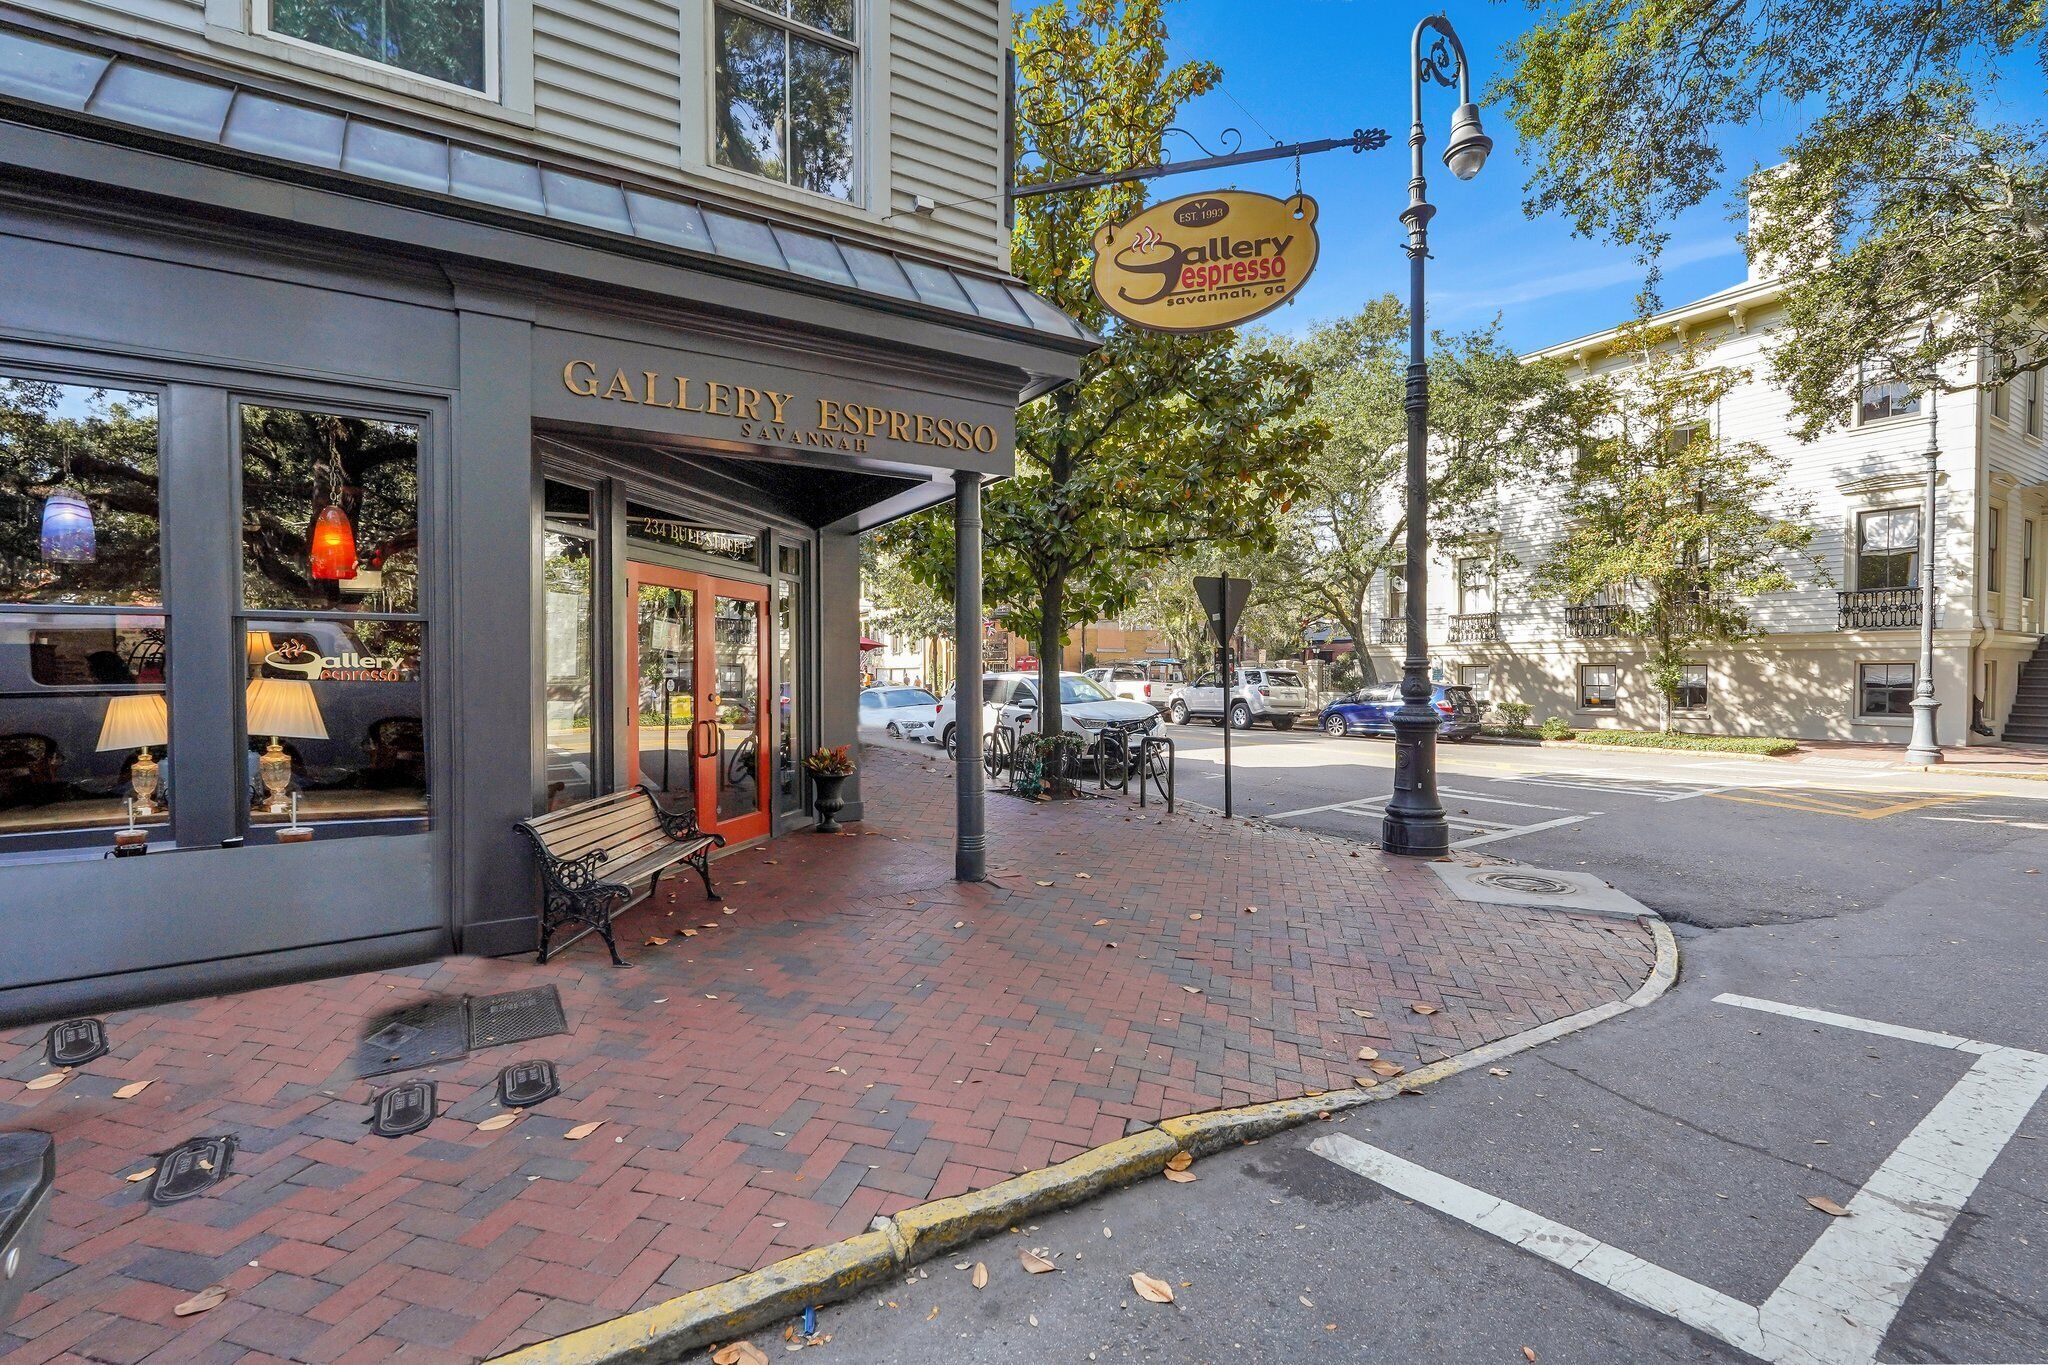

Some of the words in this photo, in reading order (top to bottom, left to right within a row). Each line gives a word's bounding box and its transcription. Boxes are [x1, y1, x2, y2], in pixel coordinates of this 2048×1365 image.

[1179, 211, 1198, 223] EST.
[1201, 208, 1224, 219] 1993
[1114, 235, 1294, 305] Gallery
[1181, 255, 1286, 291] espresso
[1166, 288, 1257, 307] savannah,
[1264, 284, 1286, 296] ga
[563, 359, 795, 424] GALLERY
[817, 399, 999, 453] ESPRESSO
[741, 423, 868, 452] SAVANNAH
[643, 517, 667, 537] 234
[670, 523, 704, 546] BULL
[705, 532, 747, 555] STREET
